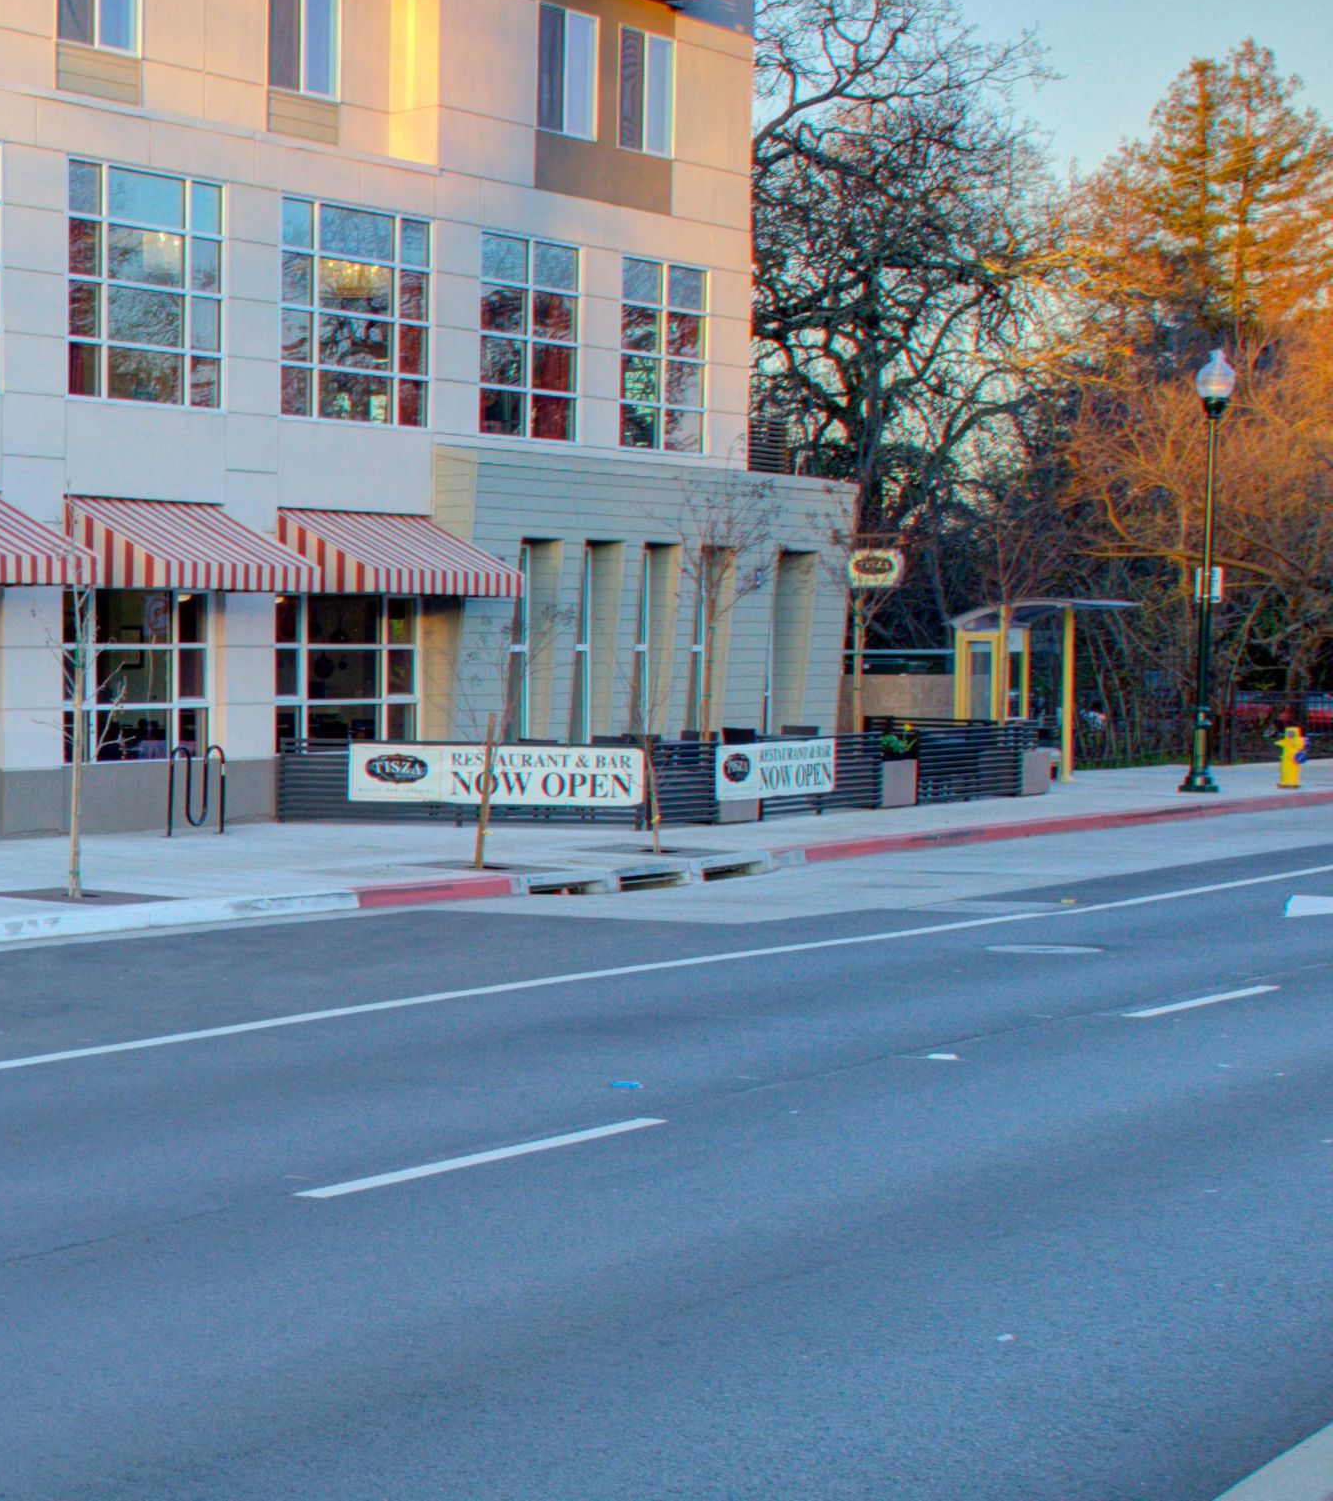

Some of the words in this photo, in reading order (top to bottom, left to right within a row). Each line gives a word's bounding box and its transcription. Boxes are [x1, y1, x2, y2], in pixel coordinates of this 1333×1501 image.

[451, 753, 571, 768] RESAURANT
[575, 754, 590, 768] &
[594, 754, 631, 768] BAR
[759, 747, 808, 762] RESTAURANT
[815, 745, 832, 759] BAR
[371, 760, 422, 774] TISZA
[451, 771, 533, 797] NOW
[540, 772, 633, 798] OPEN
[758, 765, 793, 791] NOW
[795, 762, 832, 788] OPEN
